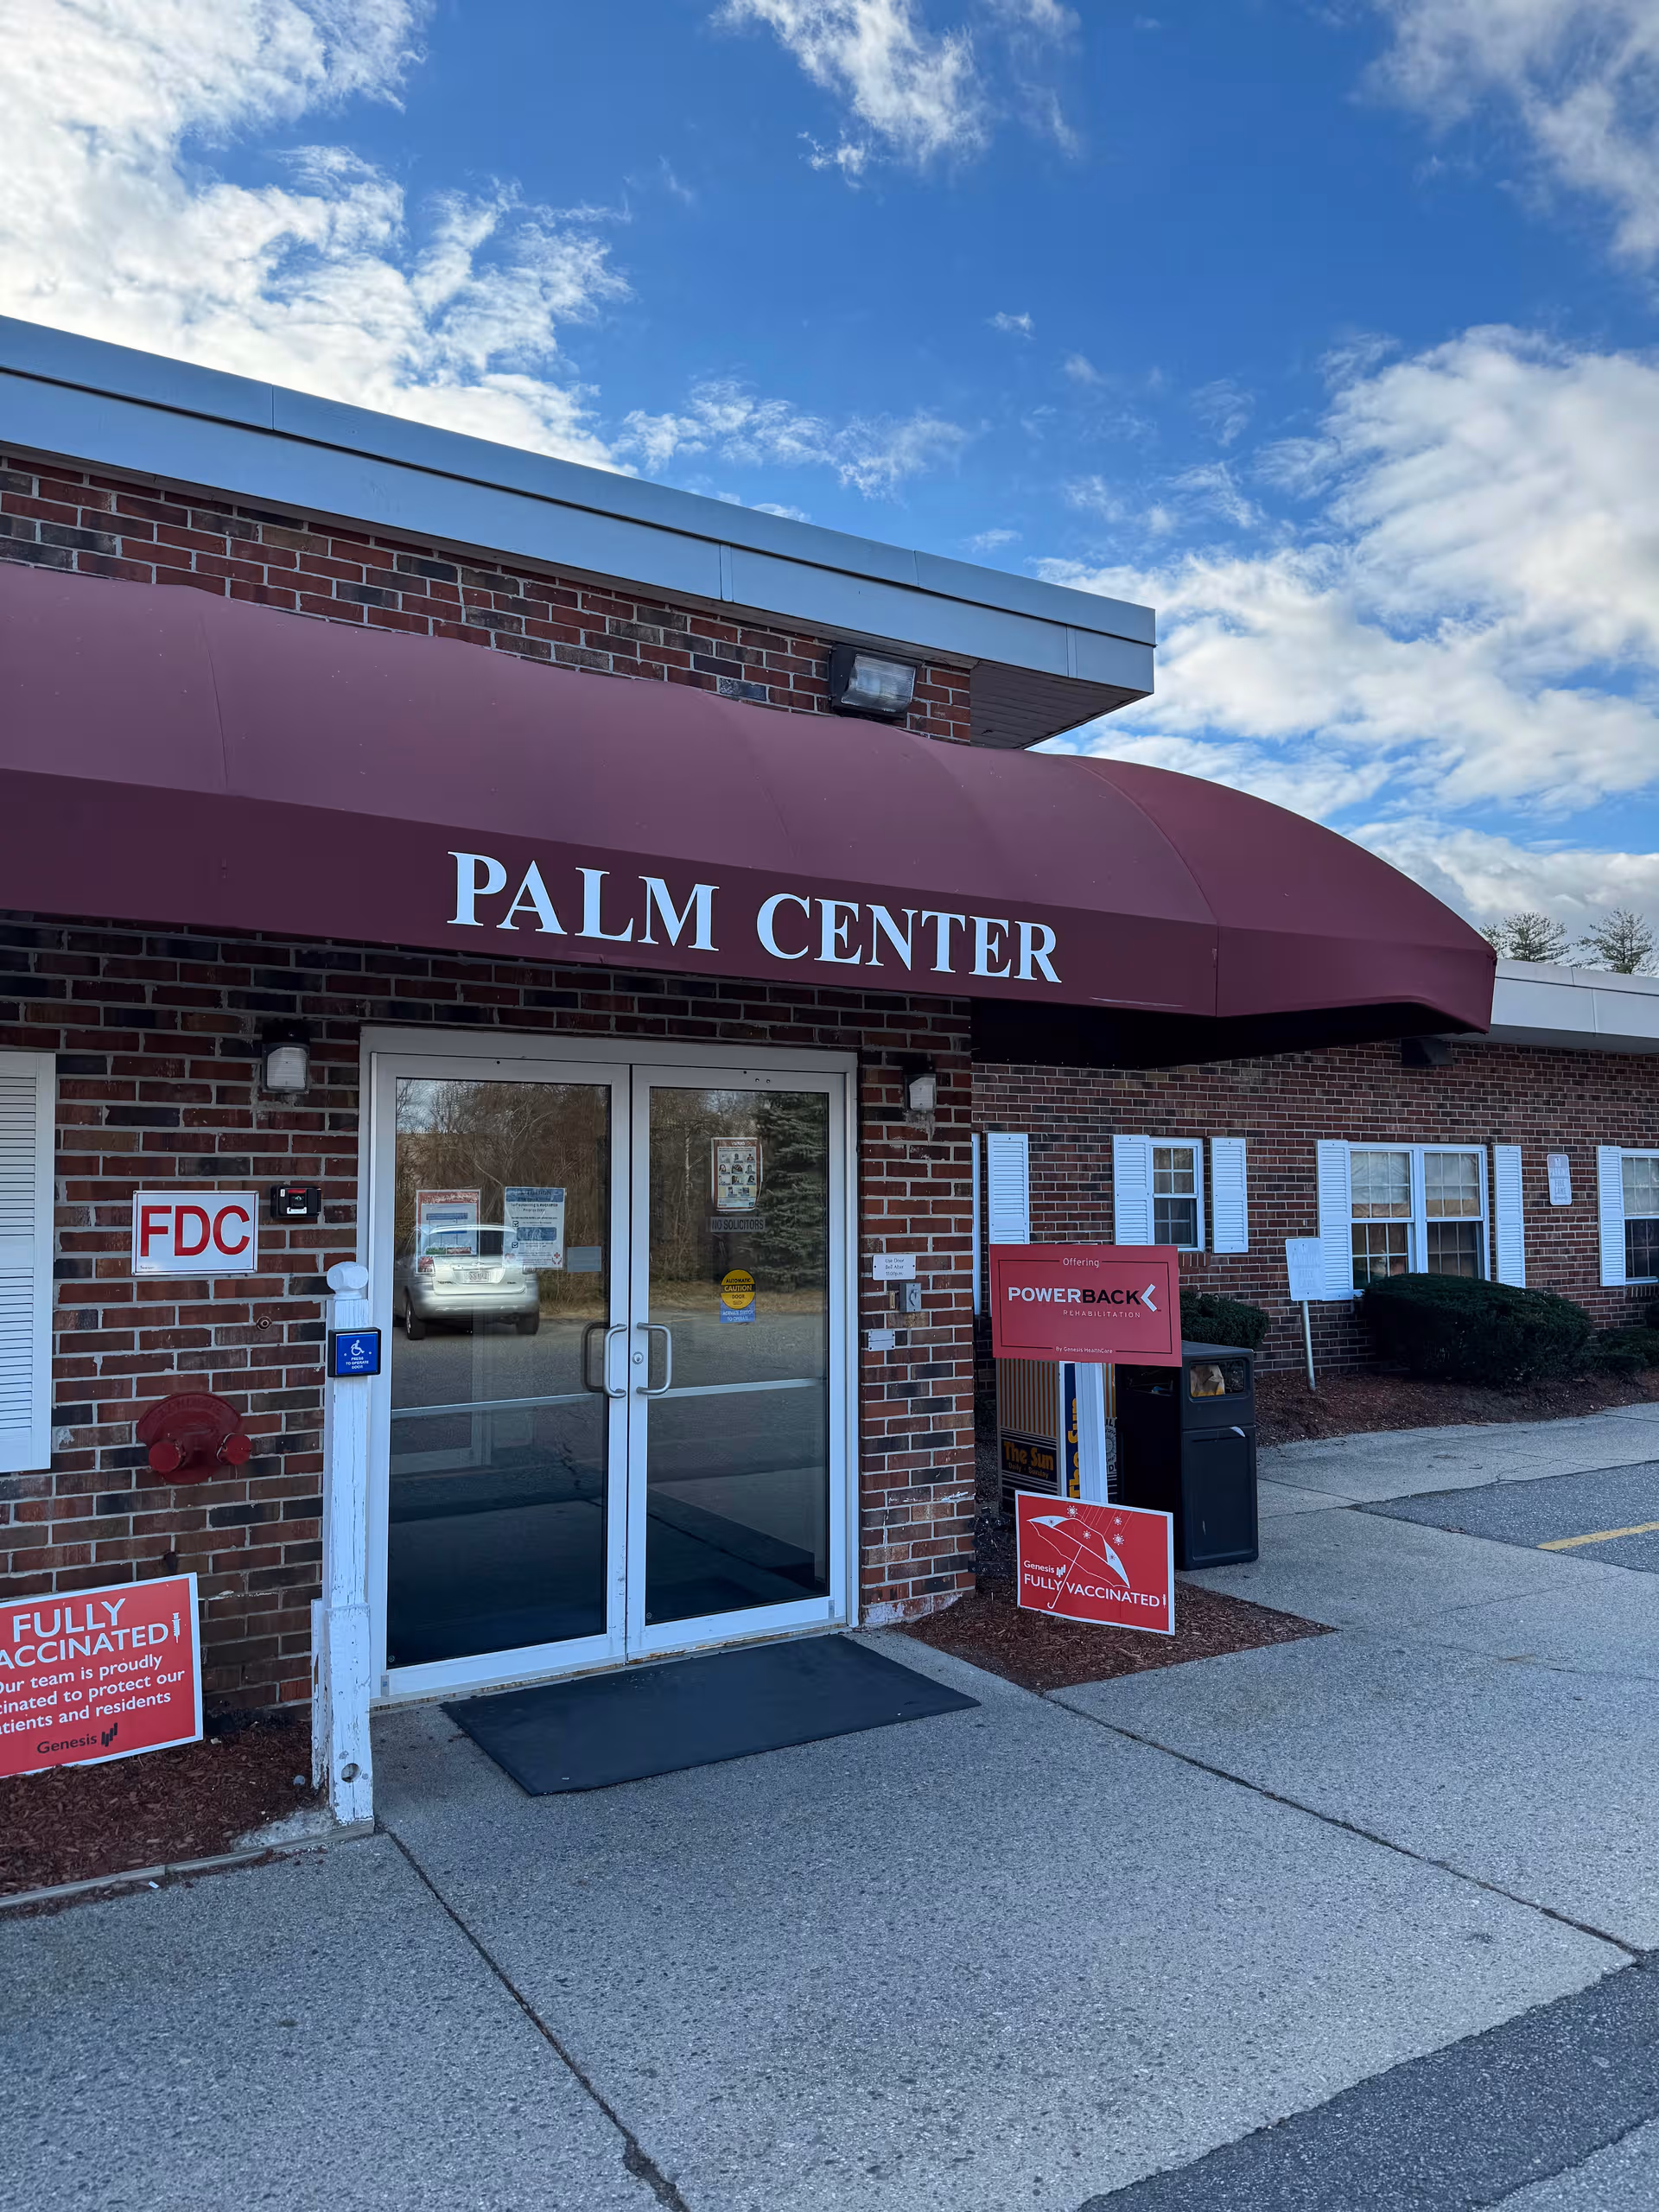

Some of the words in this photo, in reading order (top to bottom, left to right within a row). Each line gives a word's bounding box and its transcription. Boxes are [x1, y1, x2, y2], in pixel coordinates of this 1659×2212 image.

[447, 851, 720, 951] PALM
[755, 893, 1063, 983] CENTER
[140, 1205, 251, 1257] FDC
[712, 1220, 721, 1230] NO
[723, 1219, 764, 1230] SOLICITORS
[1063, 1257, 1100, 1268] Offering
[1007, 1287, 1141, 1305] POWERBACK
[1063, 1309, 1141, 1319] REHABILITATION
[1003, 1440, 1027, 1465] The
[1030, 1446, 1054, 1471] Sun
[1007, 1461, 1022, 1472] Daily
[1028, 1466, 1049, 1479] Sunday
[1023, 1560, 1055, 1574] Genesis
[1023, 1573, 1063, 1592] FULLY
[1065, 1582, 1160, 1607] VACCINATED
[12, 1598, 126, 1643] FULLY
[30, 1669, 74, 1688] team
[80, 1666, 93, 1679] is
[99, 1653, 163, 1676] proudly
[62, 1688, 83, 1702] to
[88, 1675, 151, 1702] protect
[156, 1669, 185, 1684] our
[58, 1705, 90, 1724] and
[95, 1692, 172, 1717] residents
[36, 1733, 97, 1754] Genesis
